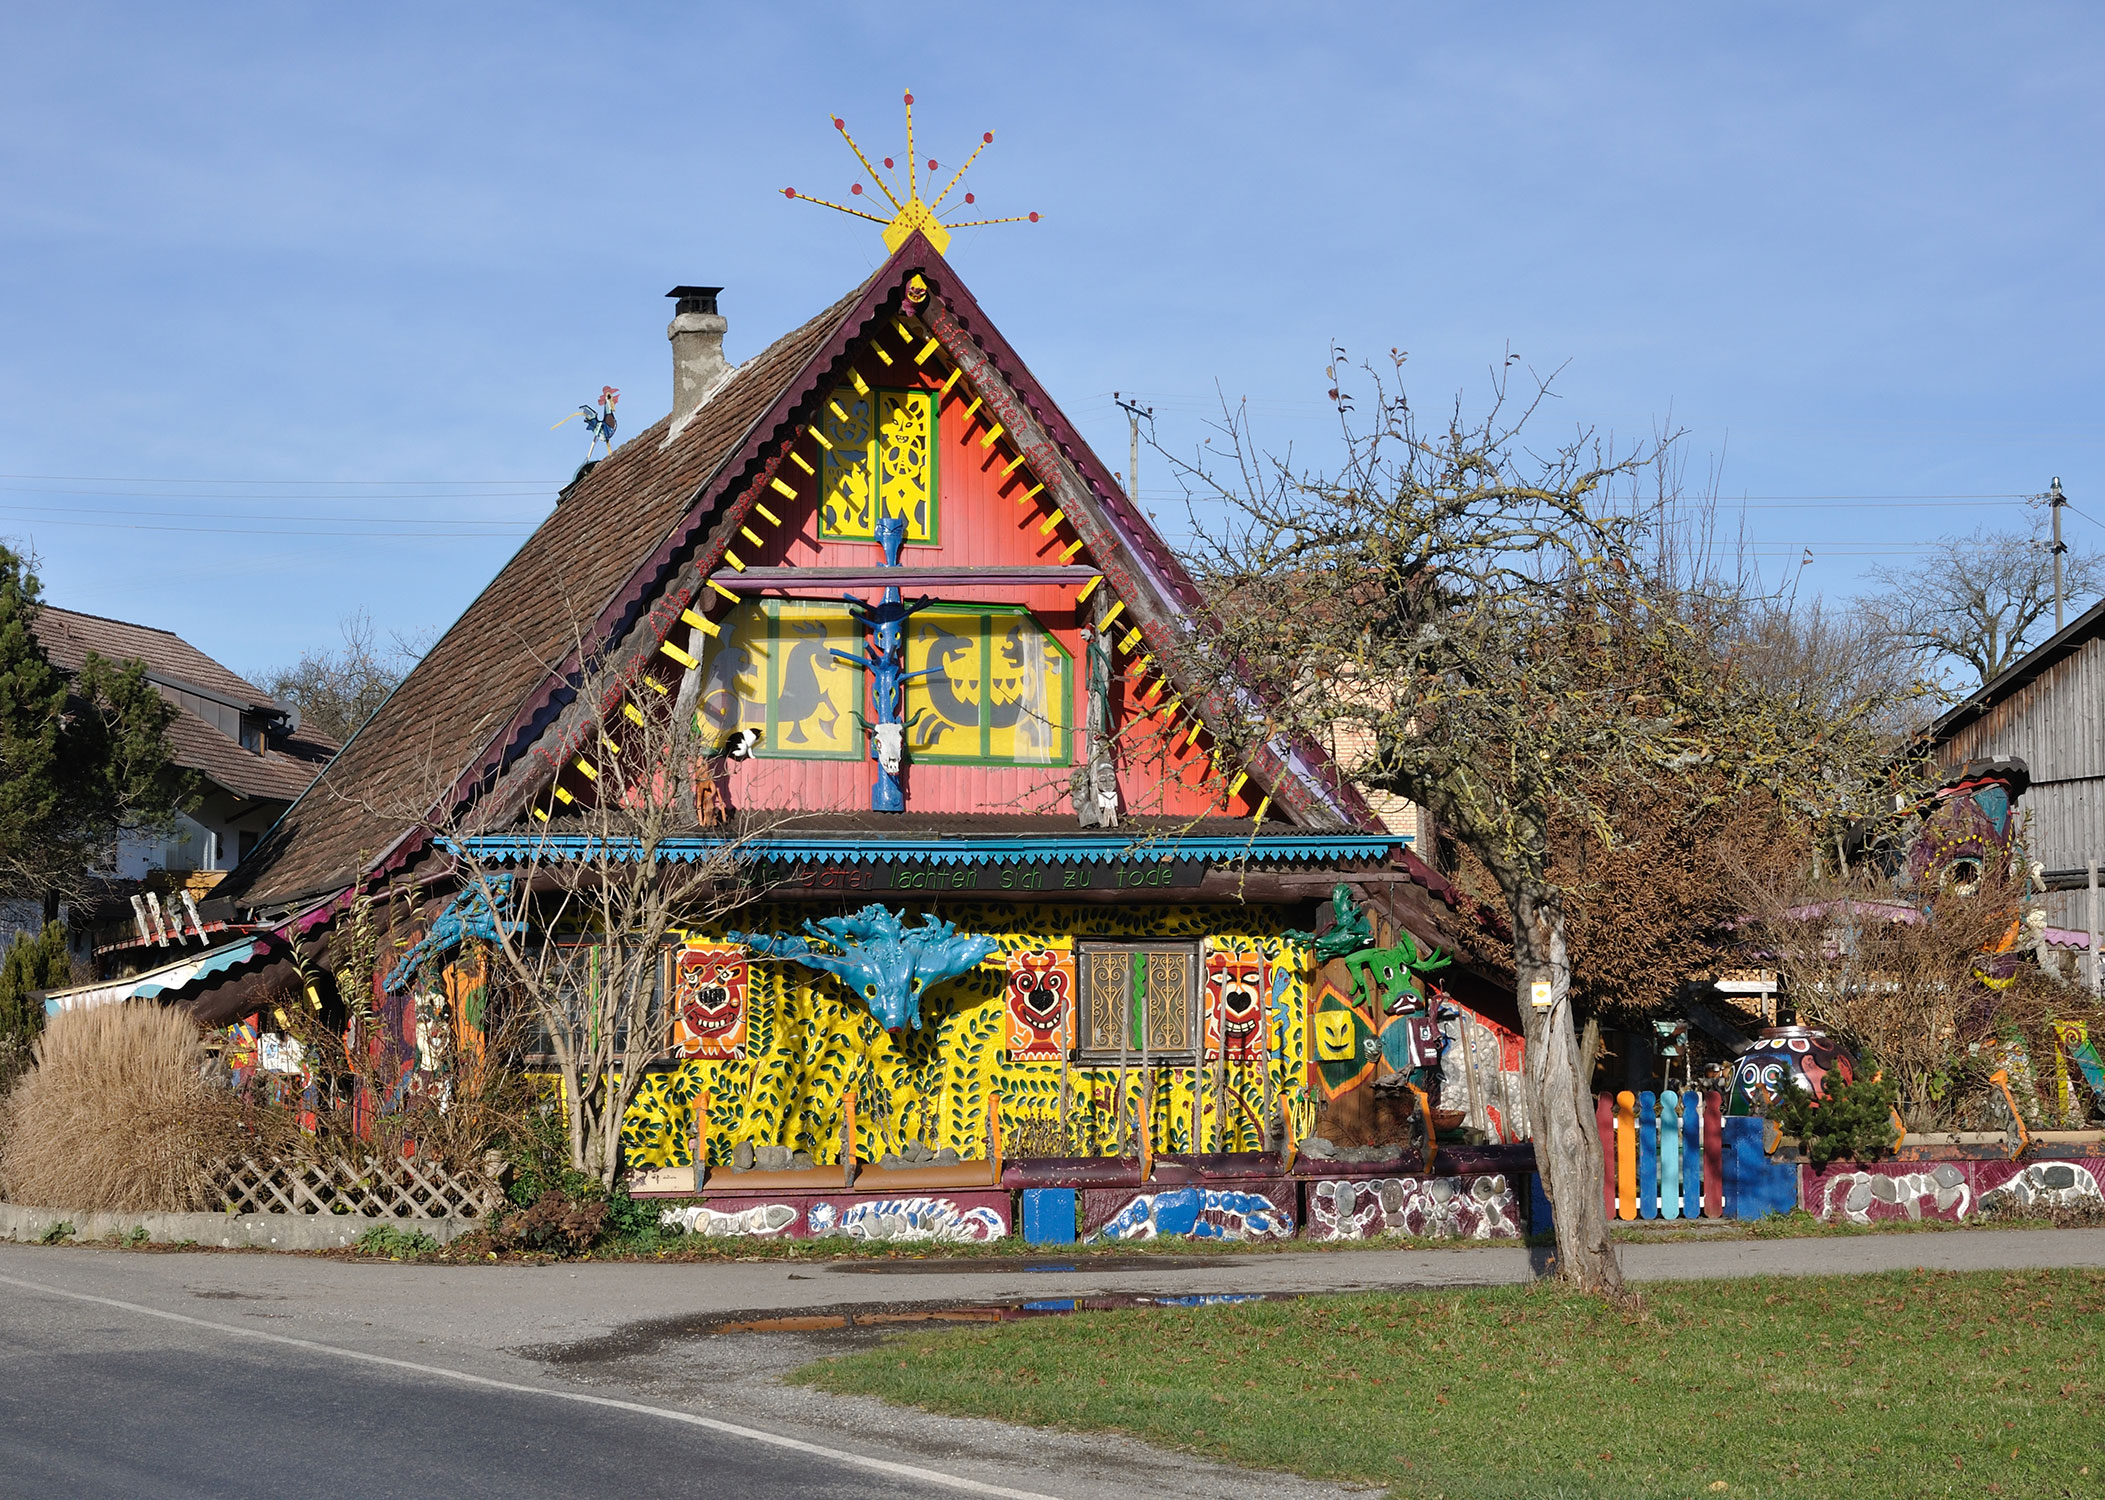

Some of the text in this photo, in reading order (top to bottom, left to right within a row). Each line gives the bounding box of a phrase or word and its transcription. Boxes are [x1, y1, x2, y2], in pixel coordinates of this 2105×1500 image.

[932, 308, 969, 359] Wir
[966, 359, 1028, 436] braten
[649, 587, 691, 643] Alle
[889, 862, 978, 889] lachten
[999, 865, 1043, 889] sich
[1063, 868, 1092, 888] zu
[1115, 864, 1173, 887] tode
